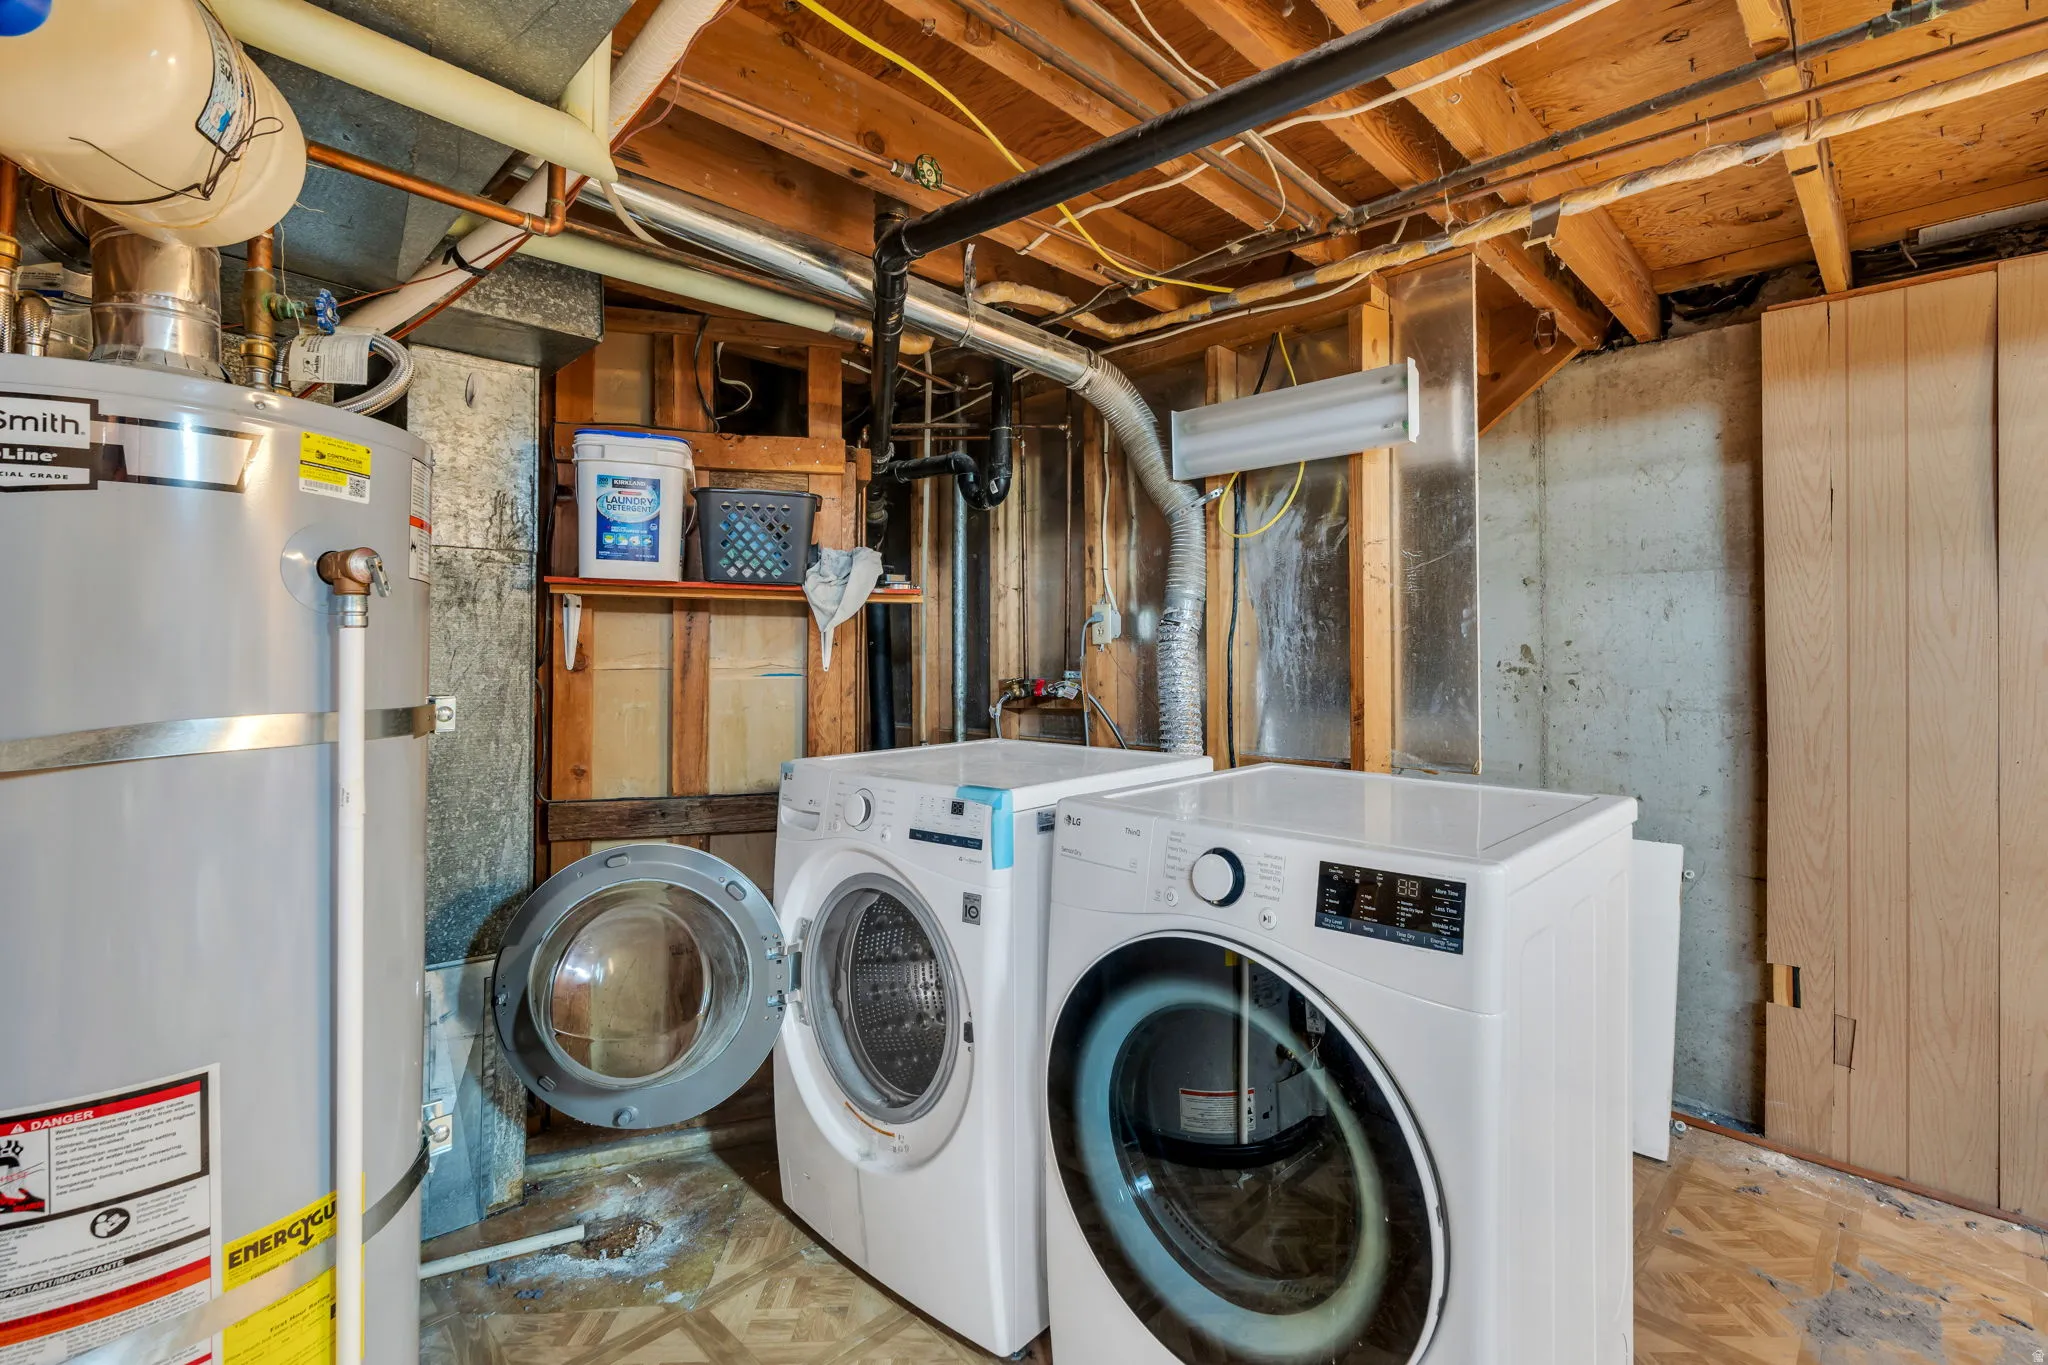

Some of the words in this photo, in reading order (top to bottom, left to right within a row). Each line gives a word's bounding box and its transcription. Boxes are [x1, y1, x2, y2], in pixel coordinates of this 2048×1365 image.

[0, 448, 53, 461] Line
[606, 496, 654, 506] LAUNDRY
[607, 504, 652, 513] DETERGENT
[1072, 818, 1081, 826] LG
[1125, 828, 1141, 836] ThinQ
[1432, 922, 1449, 930] Wrinkle
[1431, 938, 1446, 946] Energy
[30, 1110, 94, 1131] DANGER
[270, 1320, 288, 1333] First
[290, 1308, 307, 1321] Hour
